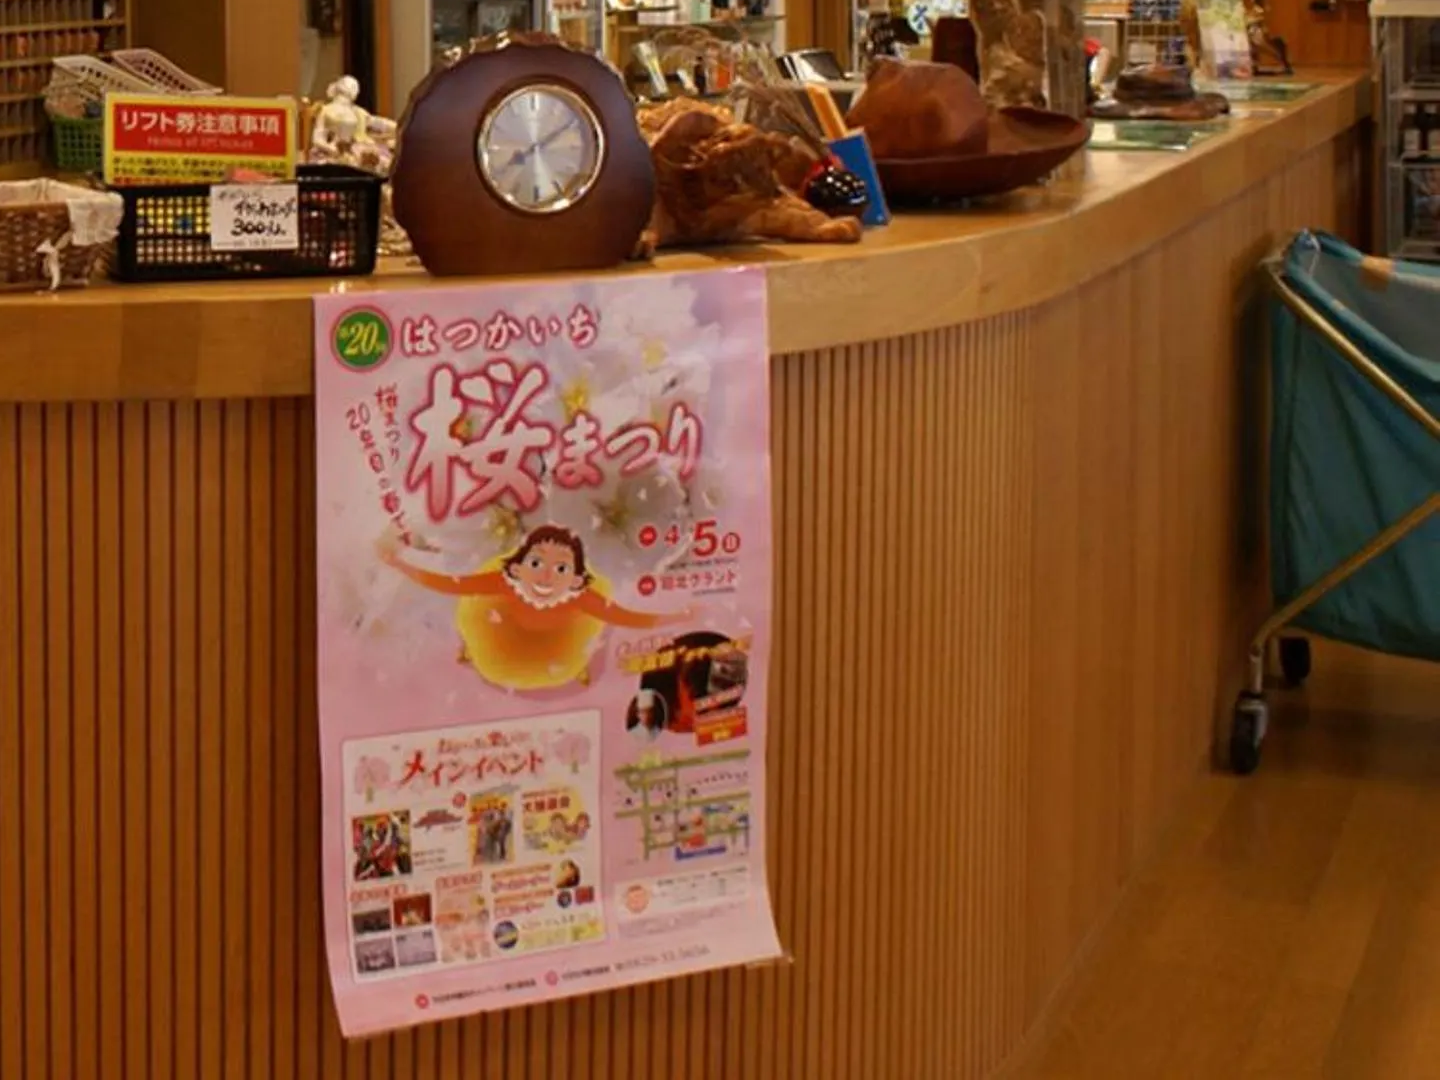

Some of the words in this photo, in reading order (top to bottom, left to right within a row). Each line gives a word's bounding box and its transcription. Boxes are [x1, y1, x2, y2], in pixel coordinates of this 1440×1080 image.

[121, 110, 280, 136] リフト券注意事項
[400, 305, 602, 355] はつかいち
[406, 360, 703, 525] 桜まつり
[693, 521, 717, 557] 5
[399, 748, 544, 788] メインイベント
